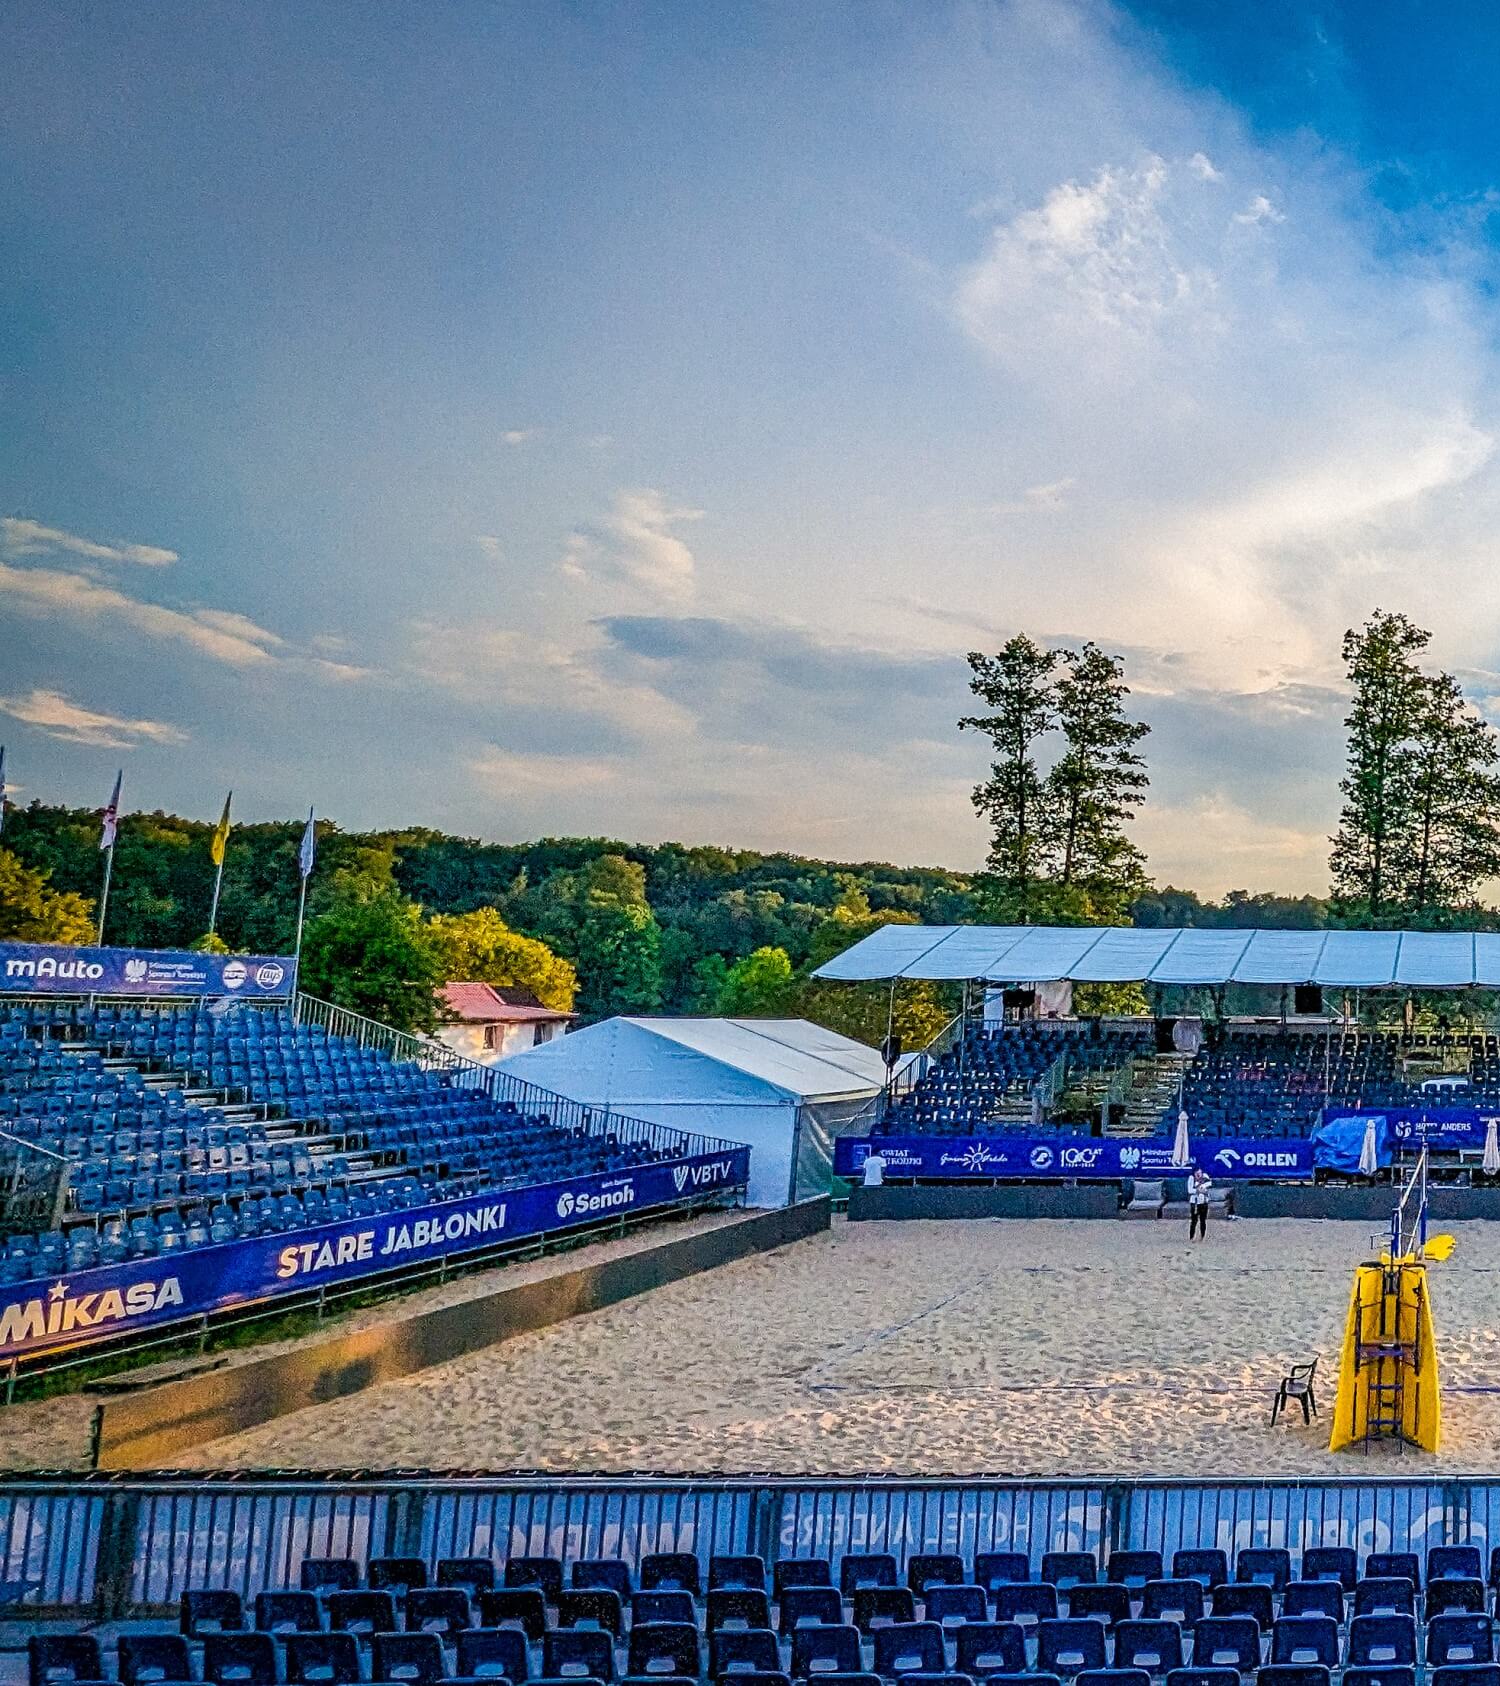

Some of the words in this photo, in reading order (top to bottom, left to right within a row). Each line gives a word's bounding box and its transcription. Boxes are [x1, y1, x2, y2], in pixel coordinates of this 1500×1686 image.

[6, 957, 104, 980] mAuto
[1440, 1122, 1472, 1132] ANDERS
[880, 1149, 909, 1157] OWIAT
[1243, 1152, 1297, 1167] ORLEN
[691, 1161, 732, 1185] VBTV
[575, 1185, 635, 1215] Senoh
[277, 1230, 374, 1278] STARE
[381, 1203, 508, 1254] JABŁONKI
